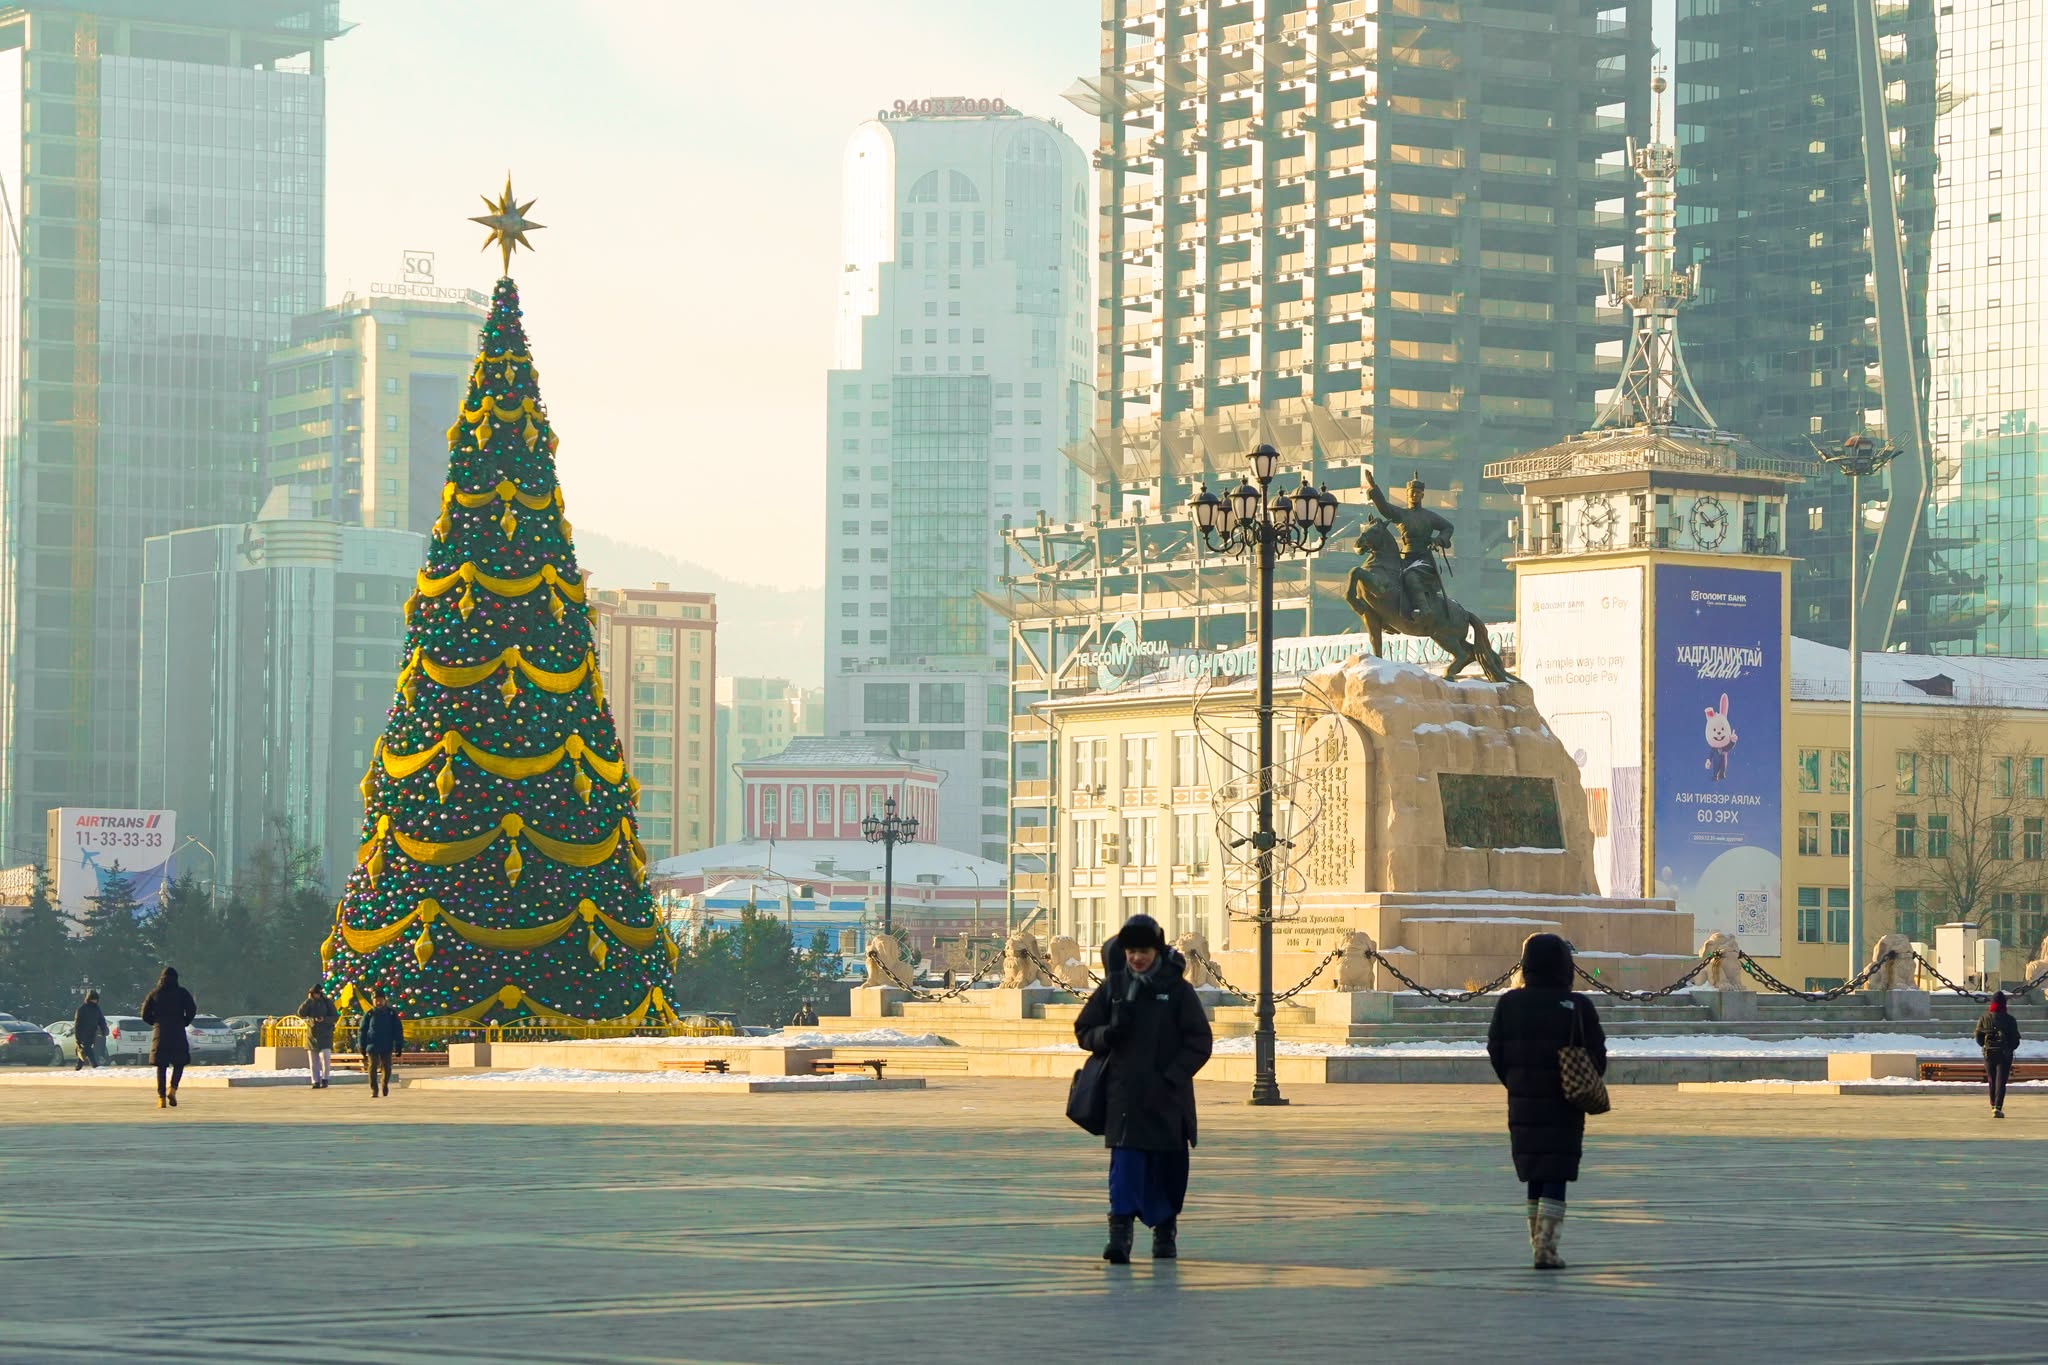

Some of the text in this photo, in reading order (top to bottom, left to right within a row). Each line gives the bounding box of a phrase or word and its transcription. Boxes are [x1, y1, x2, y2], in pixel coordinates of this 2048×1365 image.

[951, 97, 1005, 114] 2000
[405, 257, 433, 277] SQ
[1601, 596, 1629, 611] G Pay
[1699, 592, 1747, 603] ГОЛОМТ БАНК
[1535, 657, 1543, 670] A
[1576, 656, 1595, 669] way
[1598, 655, 1606, 666] to
[1608, 655, 1625, 668] pay
[1677, 645, 1762, 667] ХАДГАЛАМЖТАЙ
[1544, 670, 1619, 686] with Google Pay
[1675, 792, 1761, 805] АЗИ ТИВЭЭР АЯЛАХ
[75, 815, 145, 828] AIRTRANS
[1697, 809, 1739, 823] 60 ЭРХ
